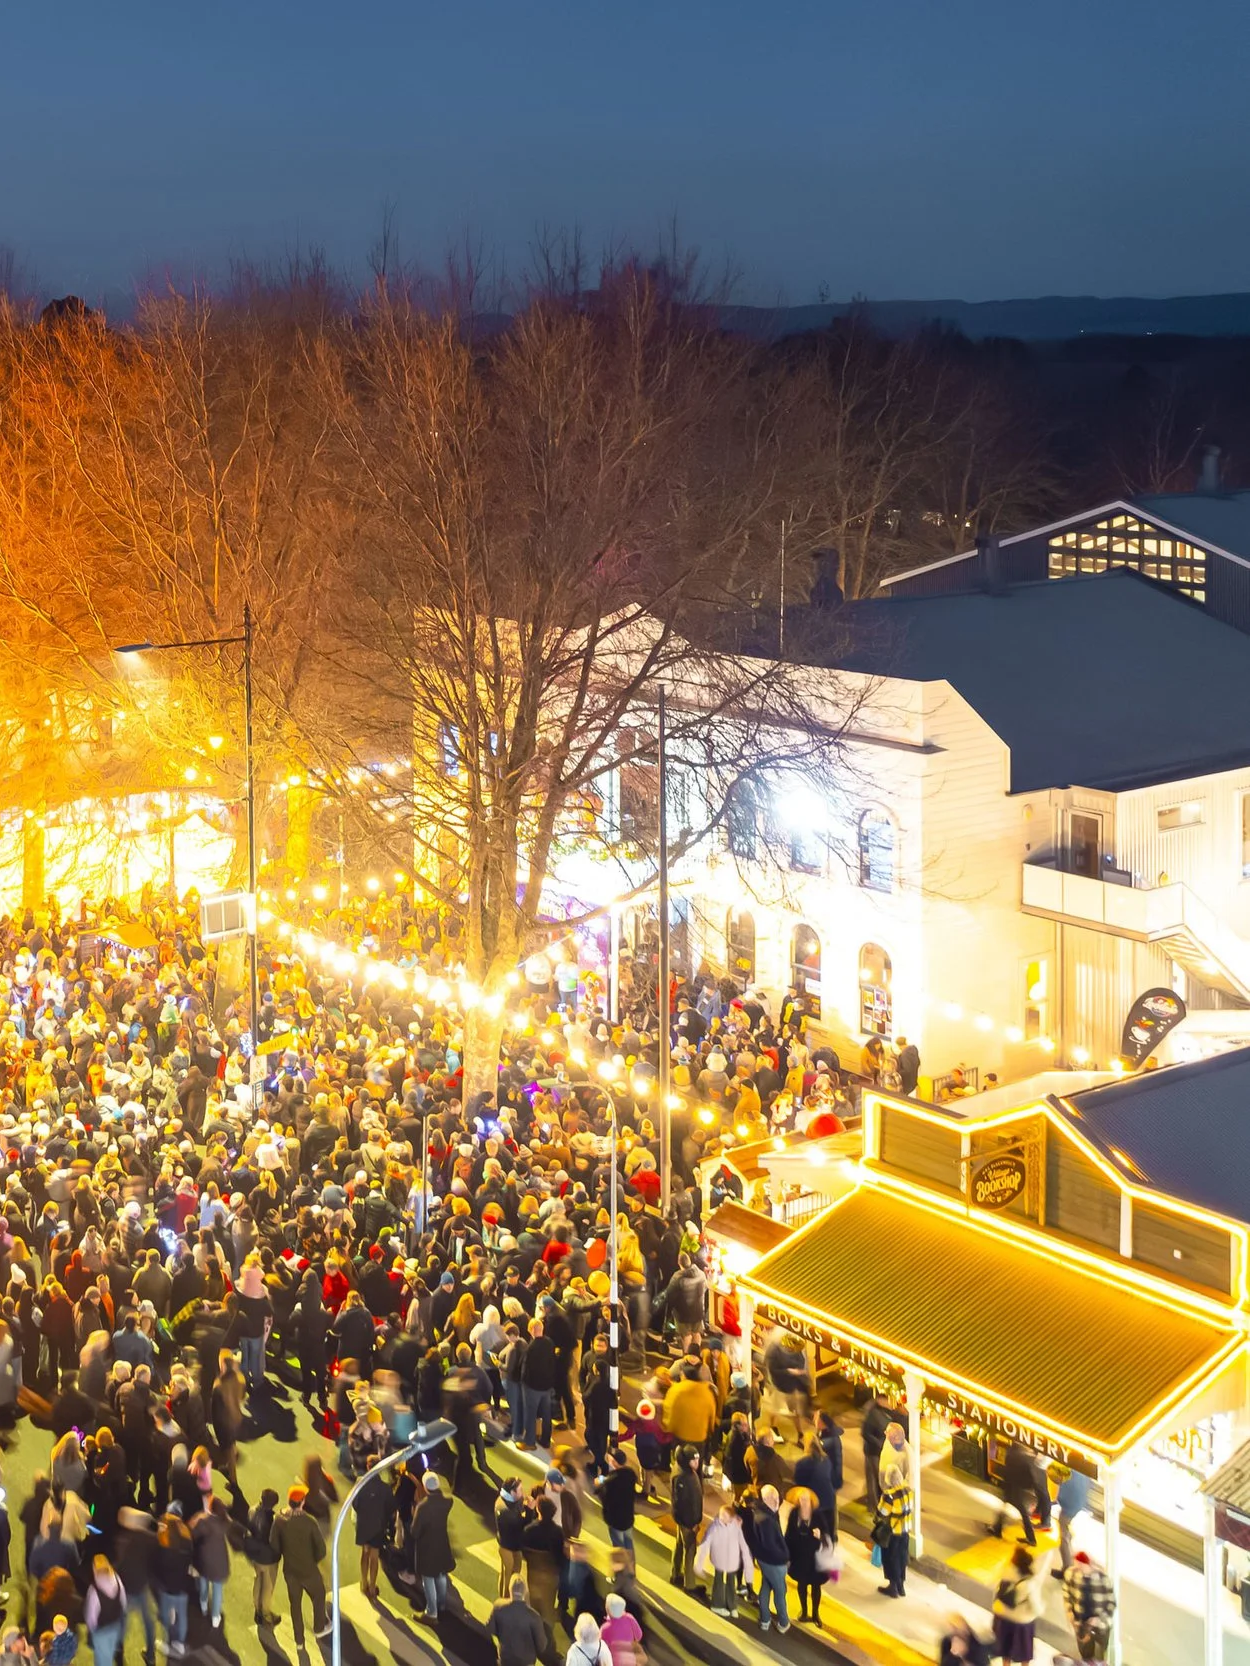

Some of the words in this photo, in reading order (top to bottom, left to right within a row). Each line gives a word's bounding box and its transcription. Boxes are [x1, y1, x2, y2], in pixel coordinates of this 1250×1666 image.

[976, 1172, 1022, 1202] BOOKSHOP
[767, 1304, 823, 1343] BOOKS
[831, 1334, 842, 1353] &
[850, 1343, 890, 1376] FINE
[946, 1391, 1071, 1464] STATIONERY
